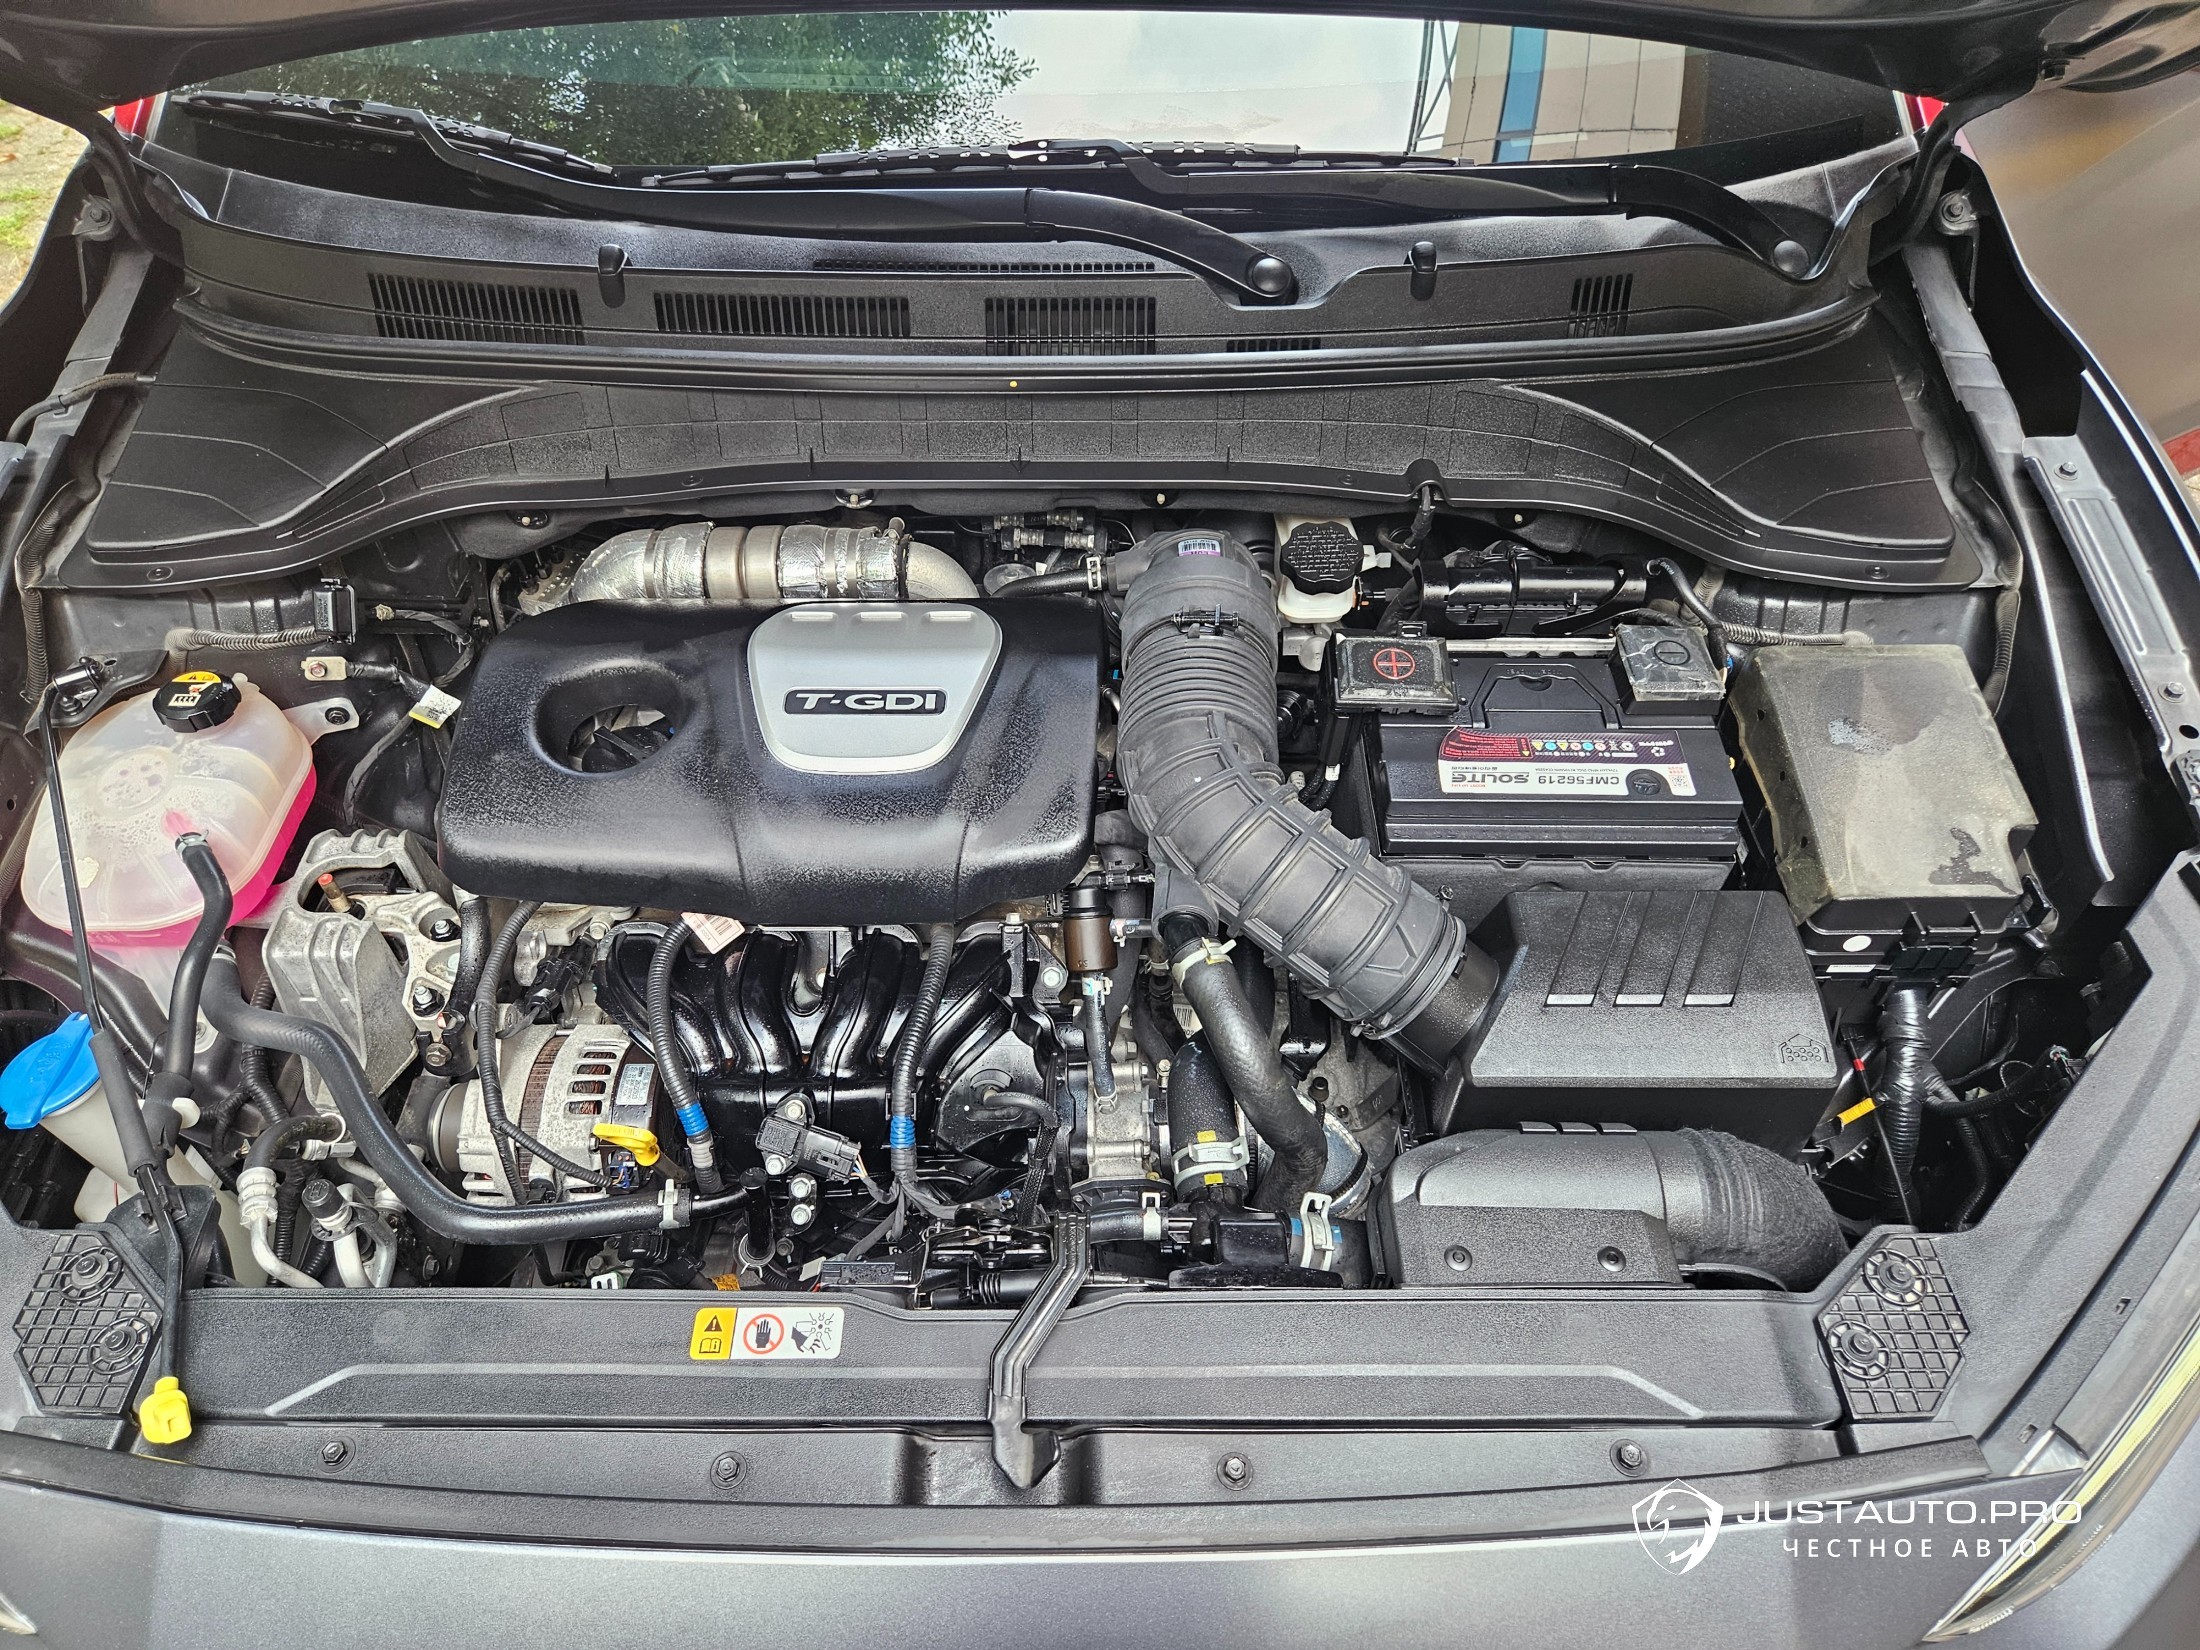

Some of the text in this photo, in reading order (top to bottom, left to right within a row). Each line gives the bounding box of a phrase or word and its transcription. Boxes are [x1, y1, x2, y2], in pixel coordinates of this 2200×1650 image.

[796, 693, 937, 711] T-GDI
[1452, 772, 1530, 784] SOLITE
[1538, 775, 1620, 785] CMF56219
